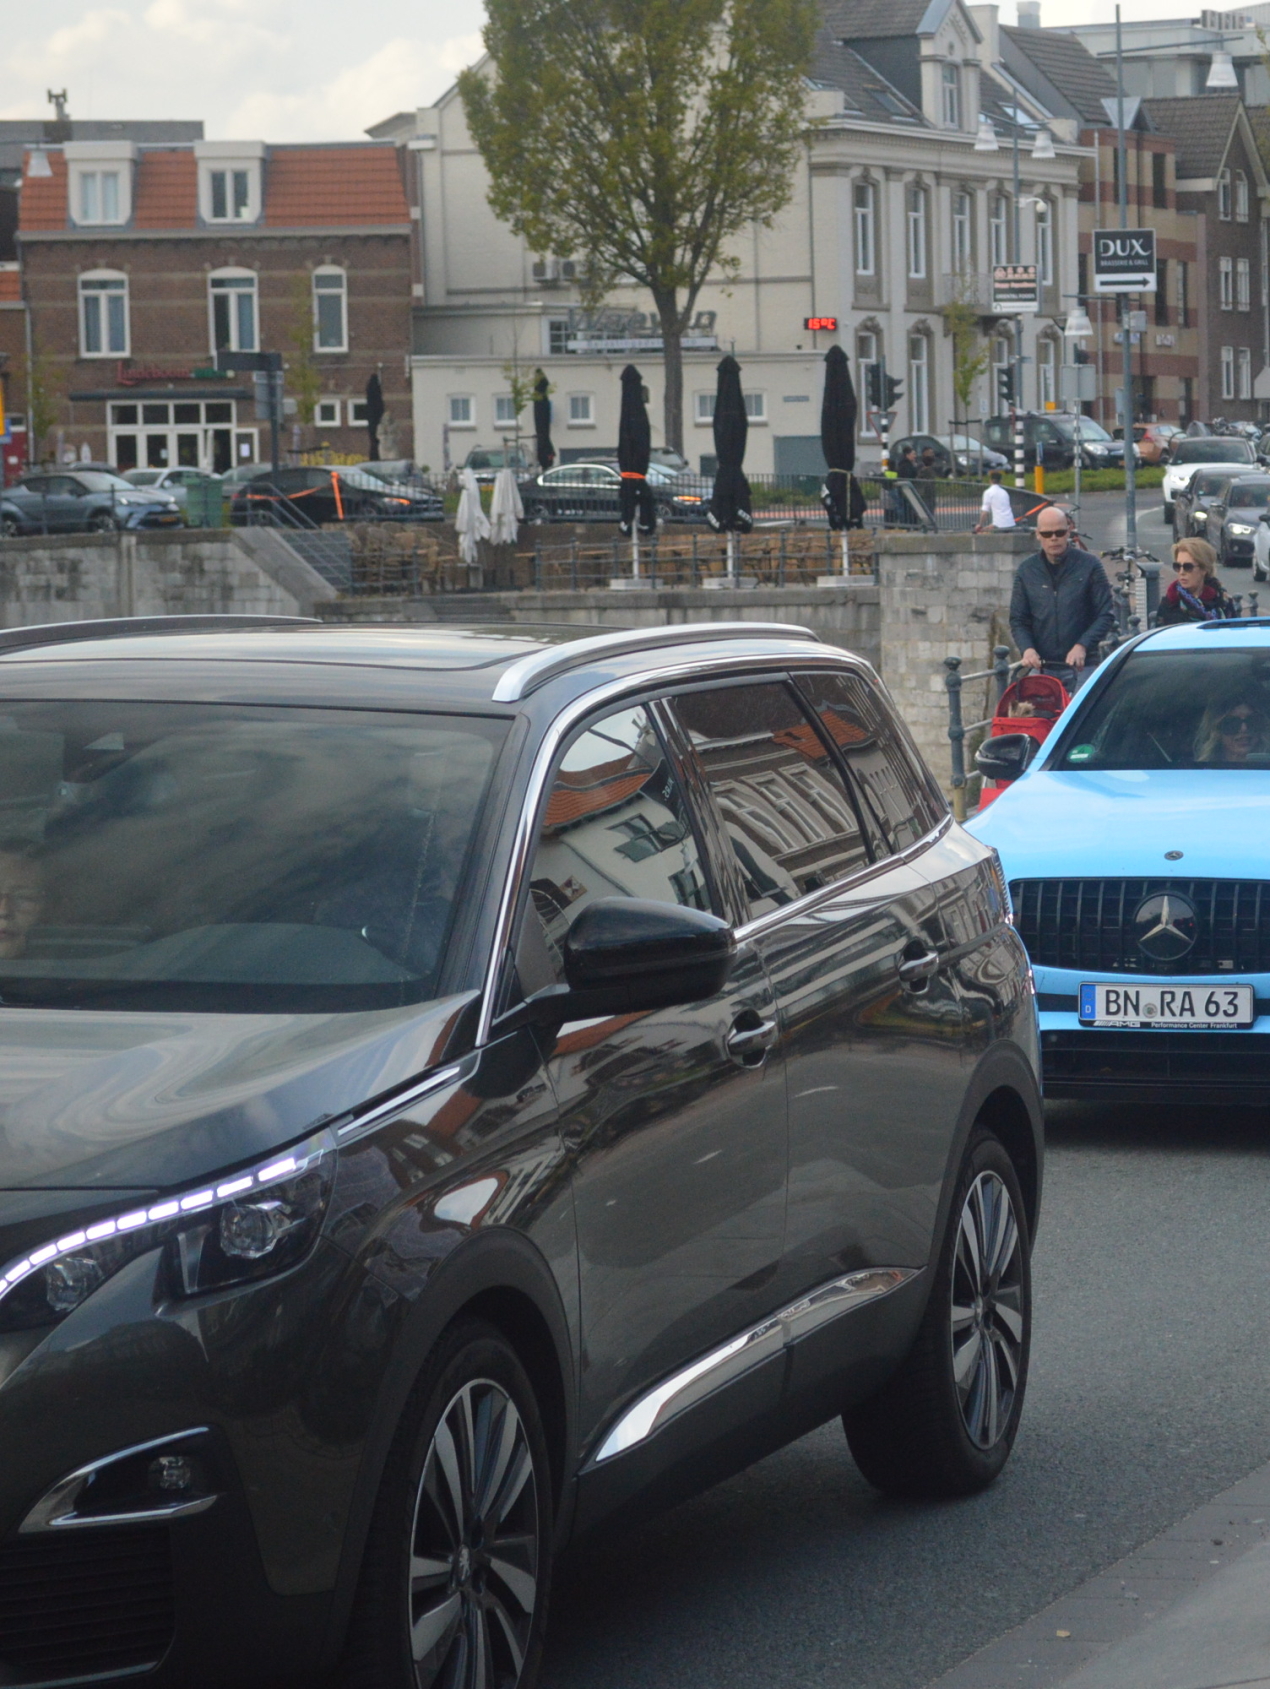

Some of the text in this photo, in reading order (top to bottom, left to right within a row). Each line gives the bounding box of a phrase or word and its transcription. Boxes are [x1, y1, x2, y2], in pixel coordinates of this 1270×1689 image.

[1100, 239, 1151, 257] DUX
[1085, 1005, 1091, 1013] D
[1105, 989, 1238, 1017] BN RA 63
